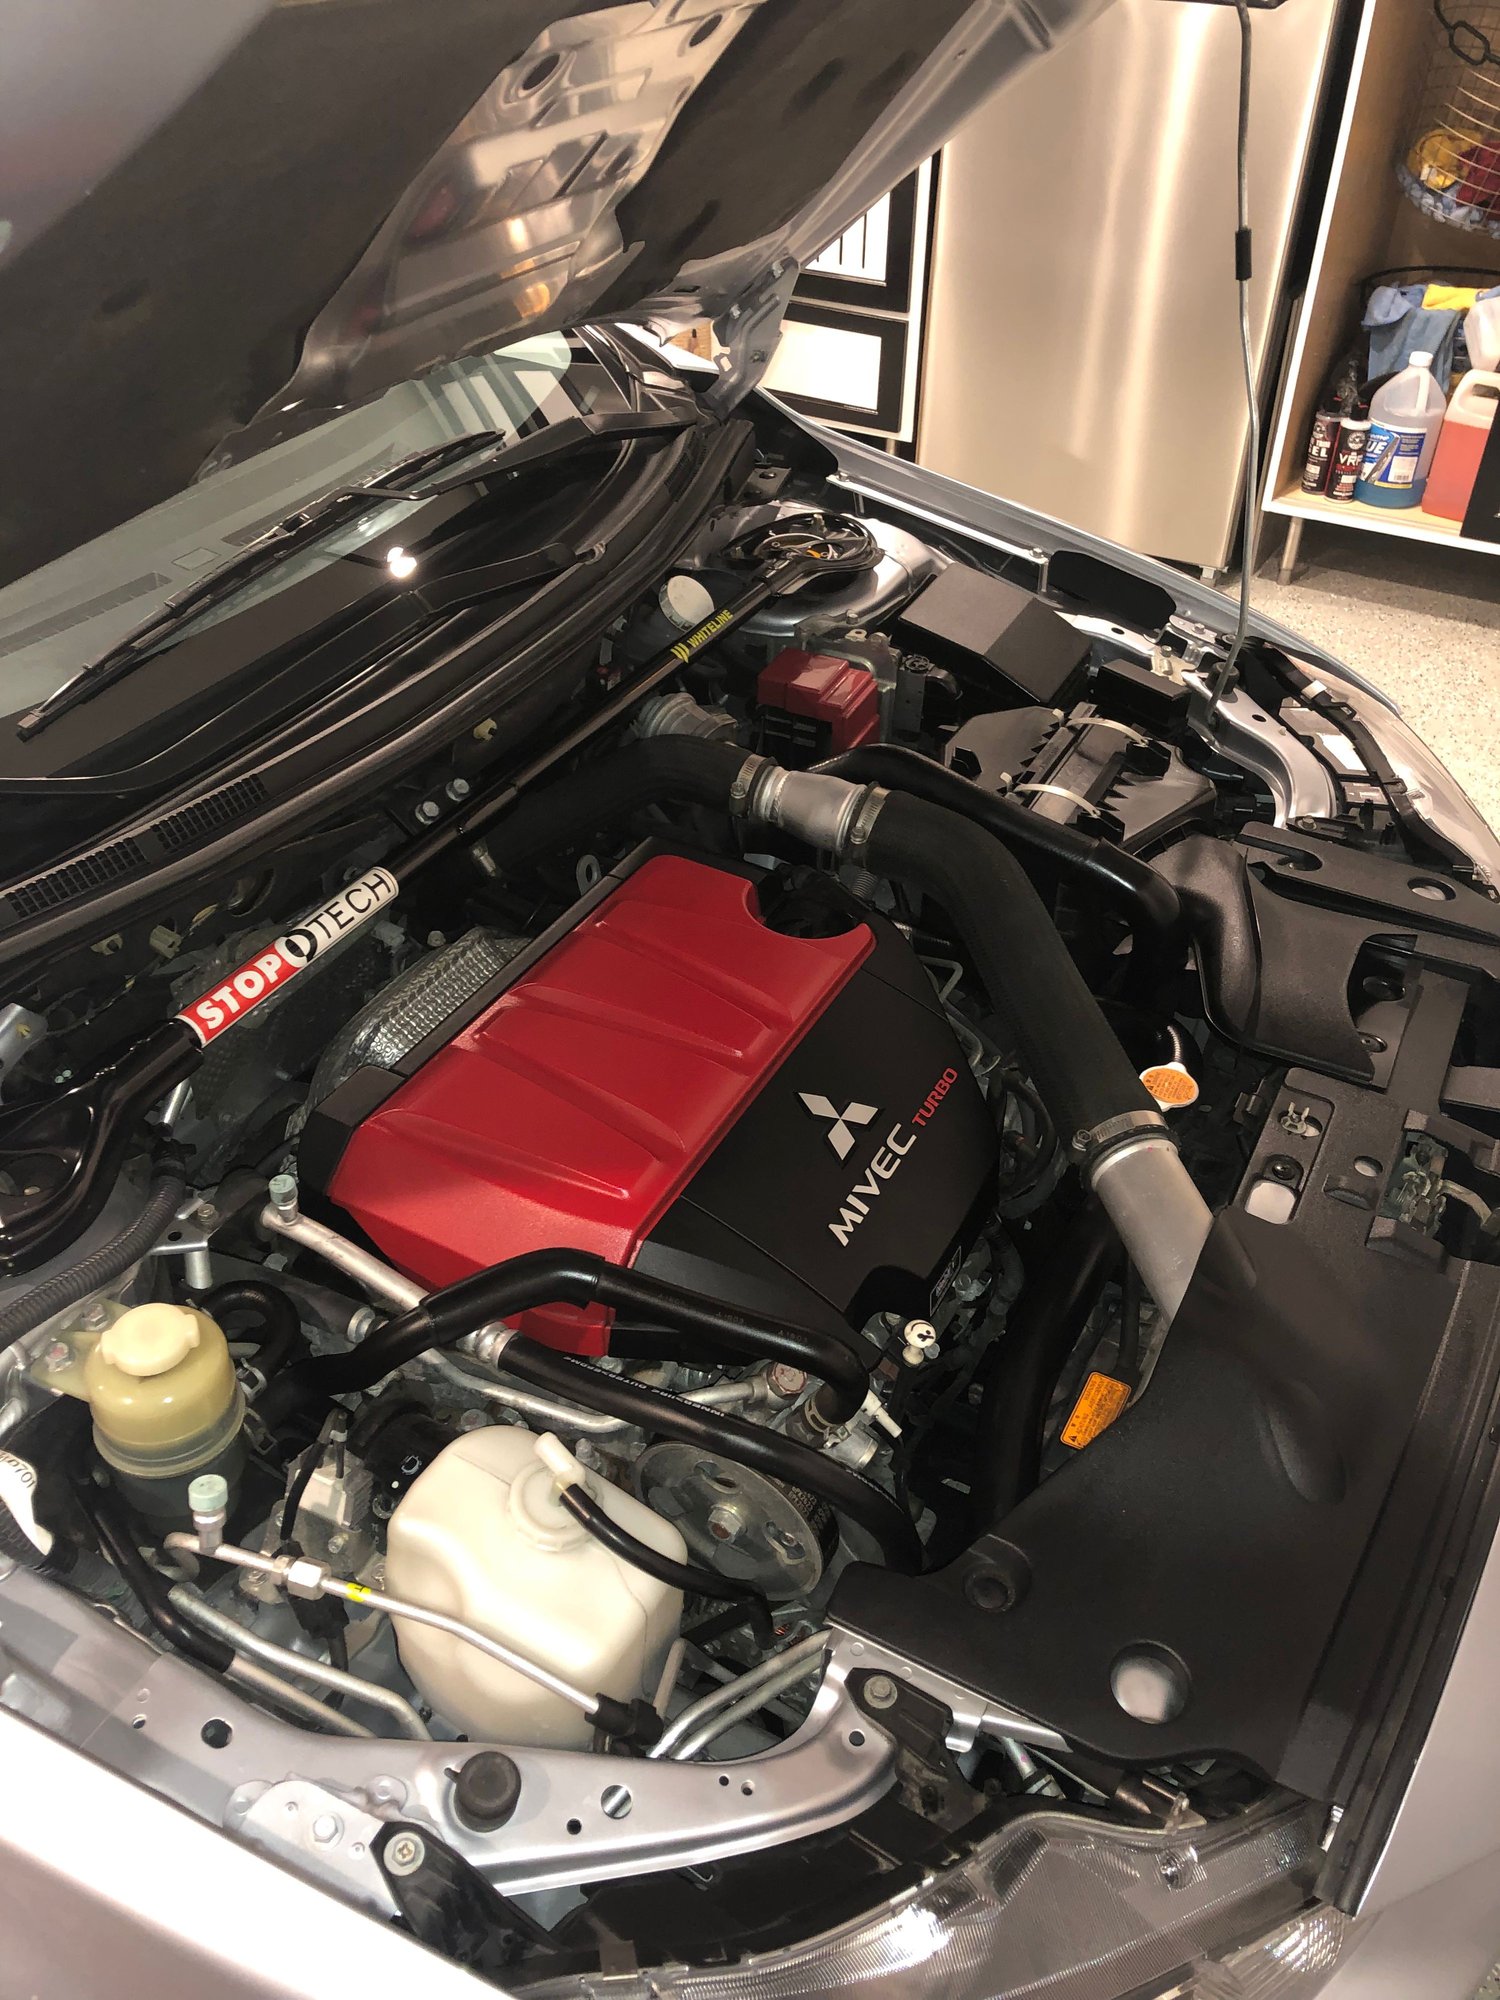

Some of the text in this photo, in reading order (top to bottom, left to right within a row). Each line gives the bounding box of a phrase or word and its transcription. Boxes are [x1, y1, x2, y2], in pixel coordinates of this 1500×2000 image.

[1366, 440, 1388, 454] UE
[687, 609, 734, 648] WHITELINE
[912, 1067, 958, 1127] TURBO
[828, 1122, 917, 1248] MIVEC
